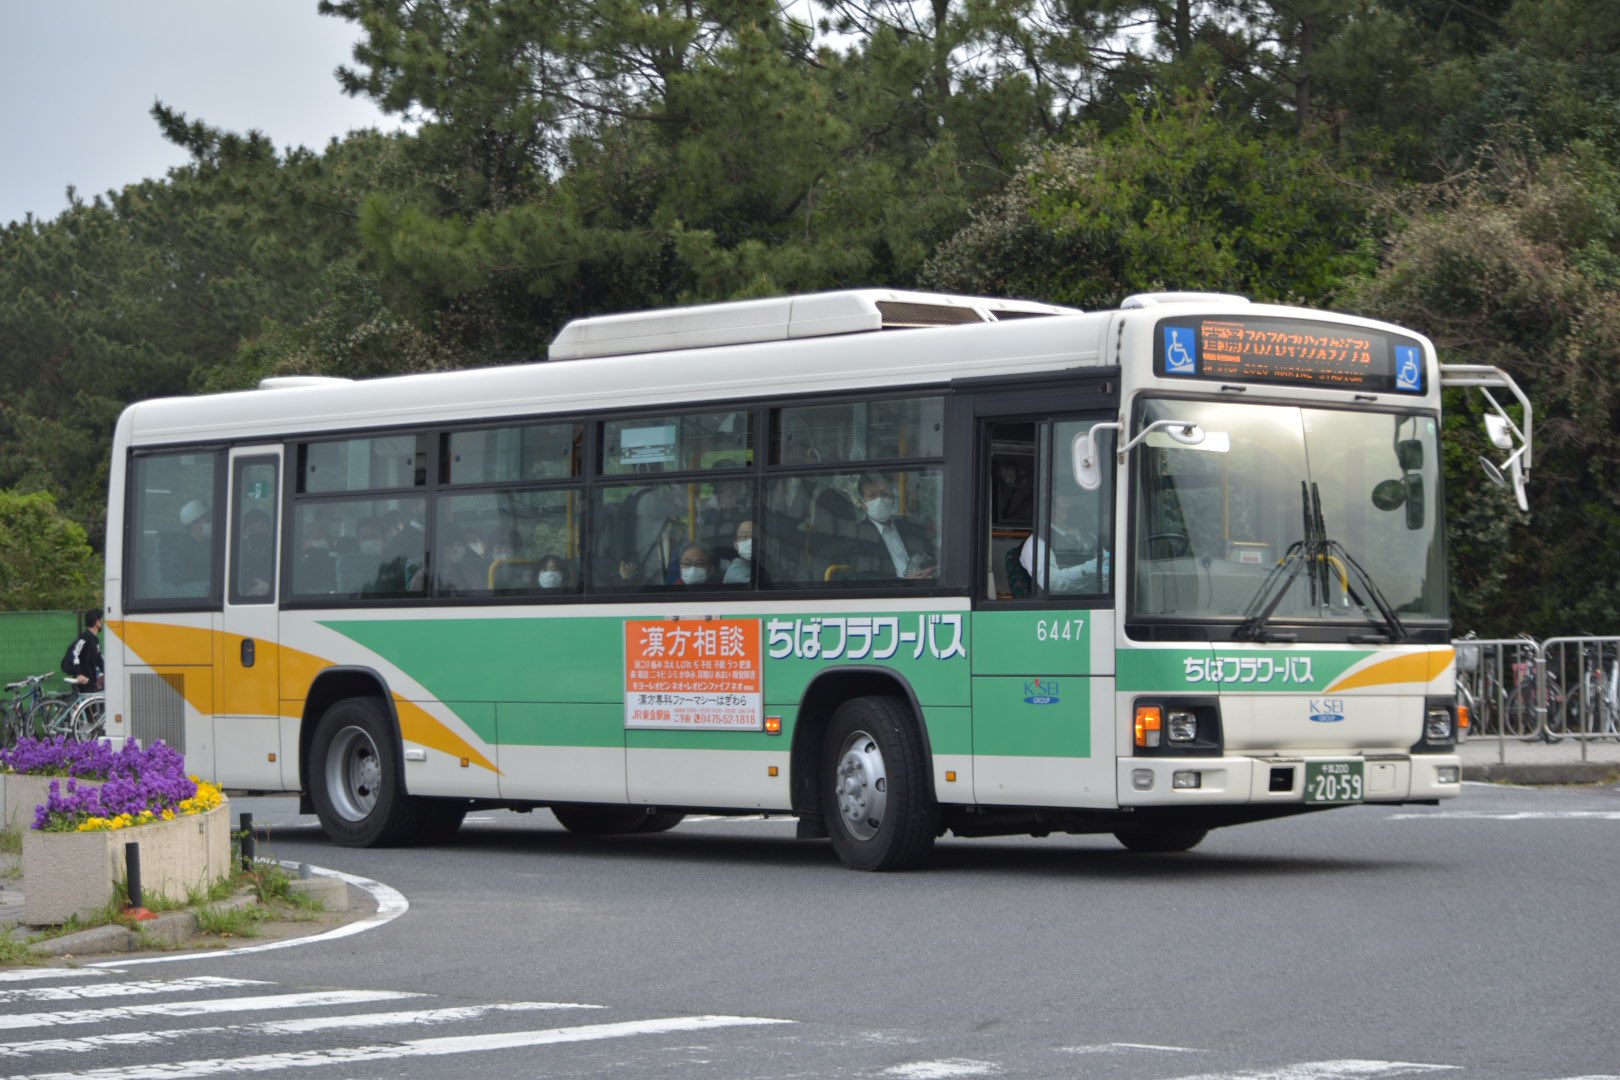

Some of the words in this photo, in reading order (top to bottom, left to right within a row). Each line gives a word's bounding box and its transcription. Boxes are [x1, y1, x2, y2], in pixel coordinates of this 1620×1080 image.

[640, 626, 746, 657] 漢方相談
[767, 614, 967, 659] ちばフラワーバス
[1037, 619, 1084, 641] 6447
[1183, 657, 1314, 683] ちばフラワーバス
[1315, 774, 1362, 801] 20-59
